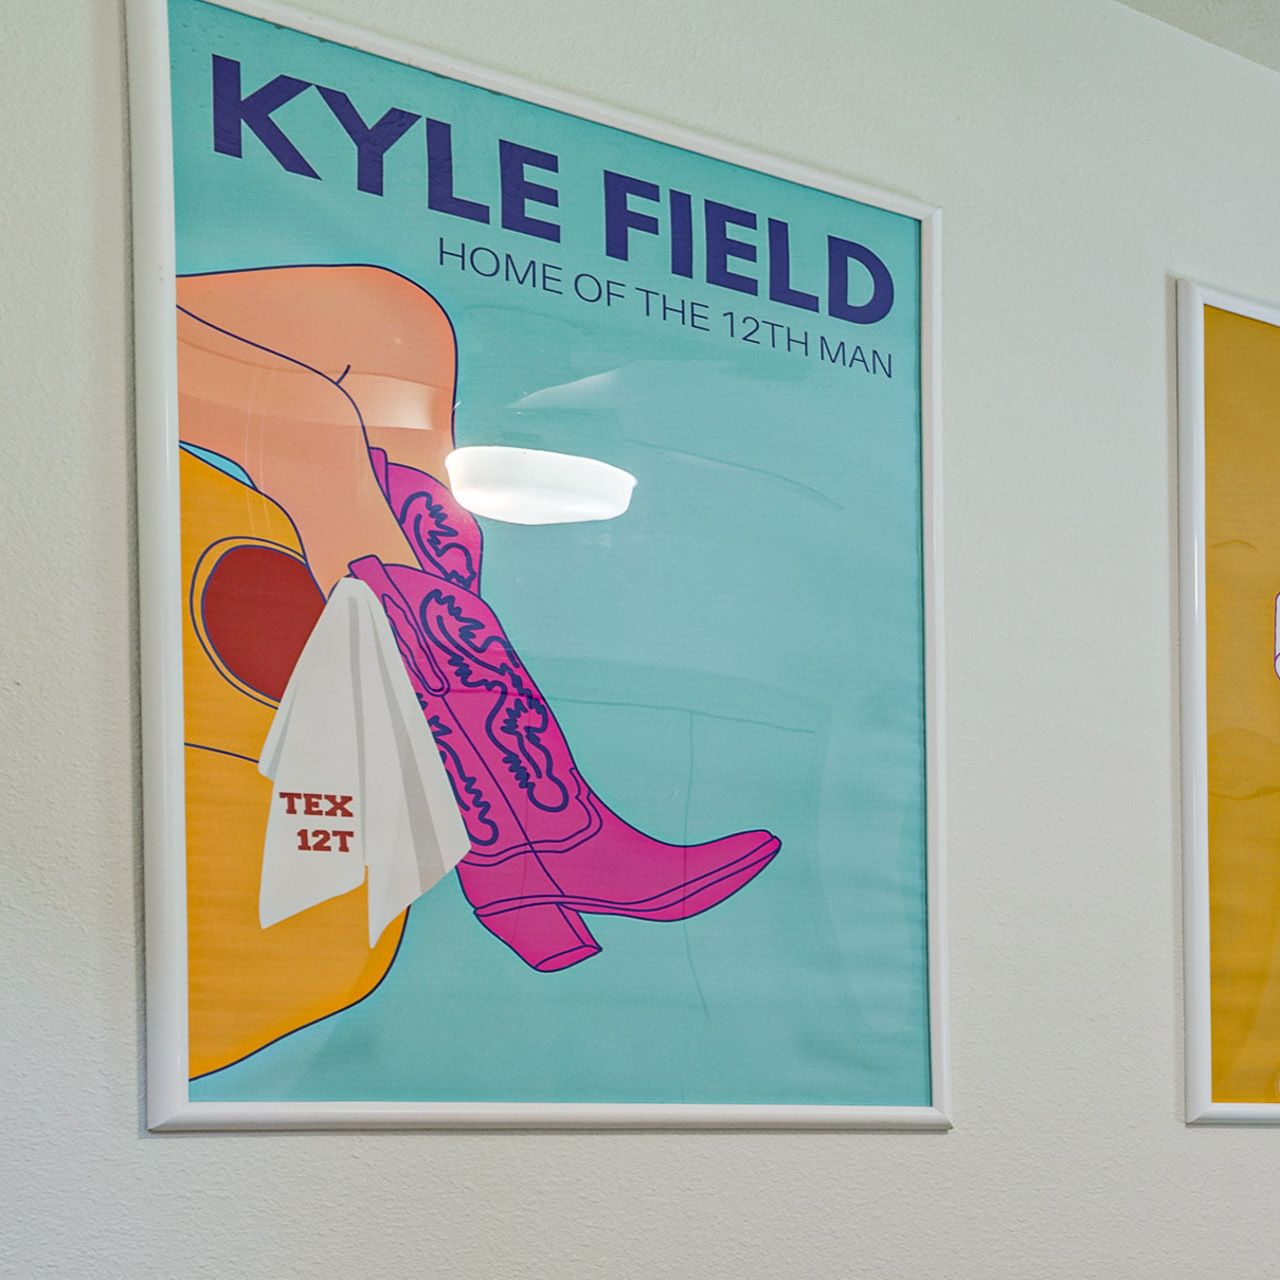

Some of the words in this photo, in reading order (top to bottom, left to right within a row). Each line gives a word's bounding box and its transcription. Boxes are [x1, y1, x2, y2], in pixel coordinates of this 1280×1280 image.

[211, 53, 561, 244] KYLE
[604, 169, 895, 326] FIELD
[439, 237, 563, 295] HOME
[574, 273, 626, 307] OF
[636, 287, 710, 332] THE
[722, 311, 808, 357] 12TH
[820, 335, 893, 379] MAN
[279, 791, 354, 818] TEX
[296, 829, 354, 853] 12T
